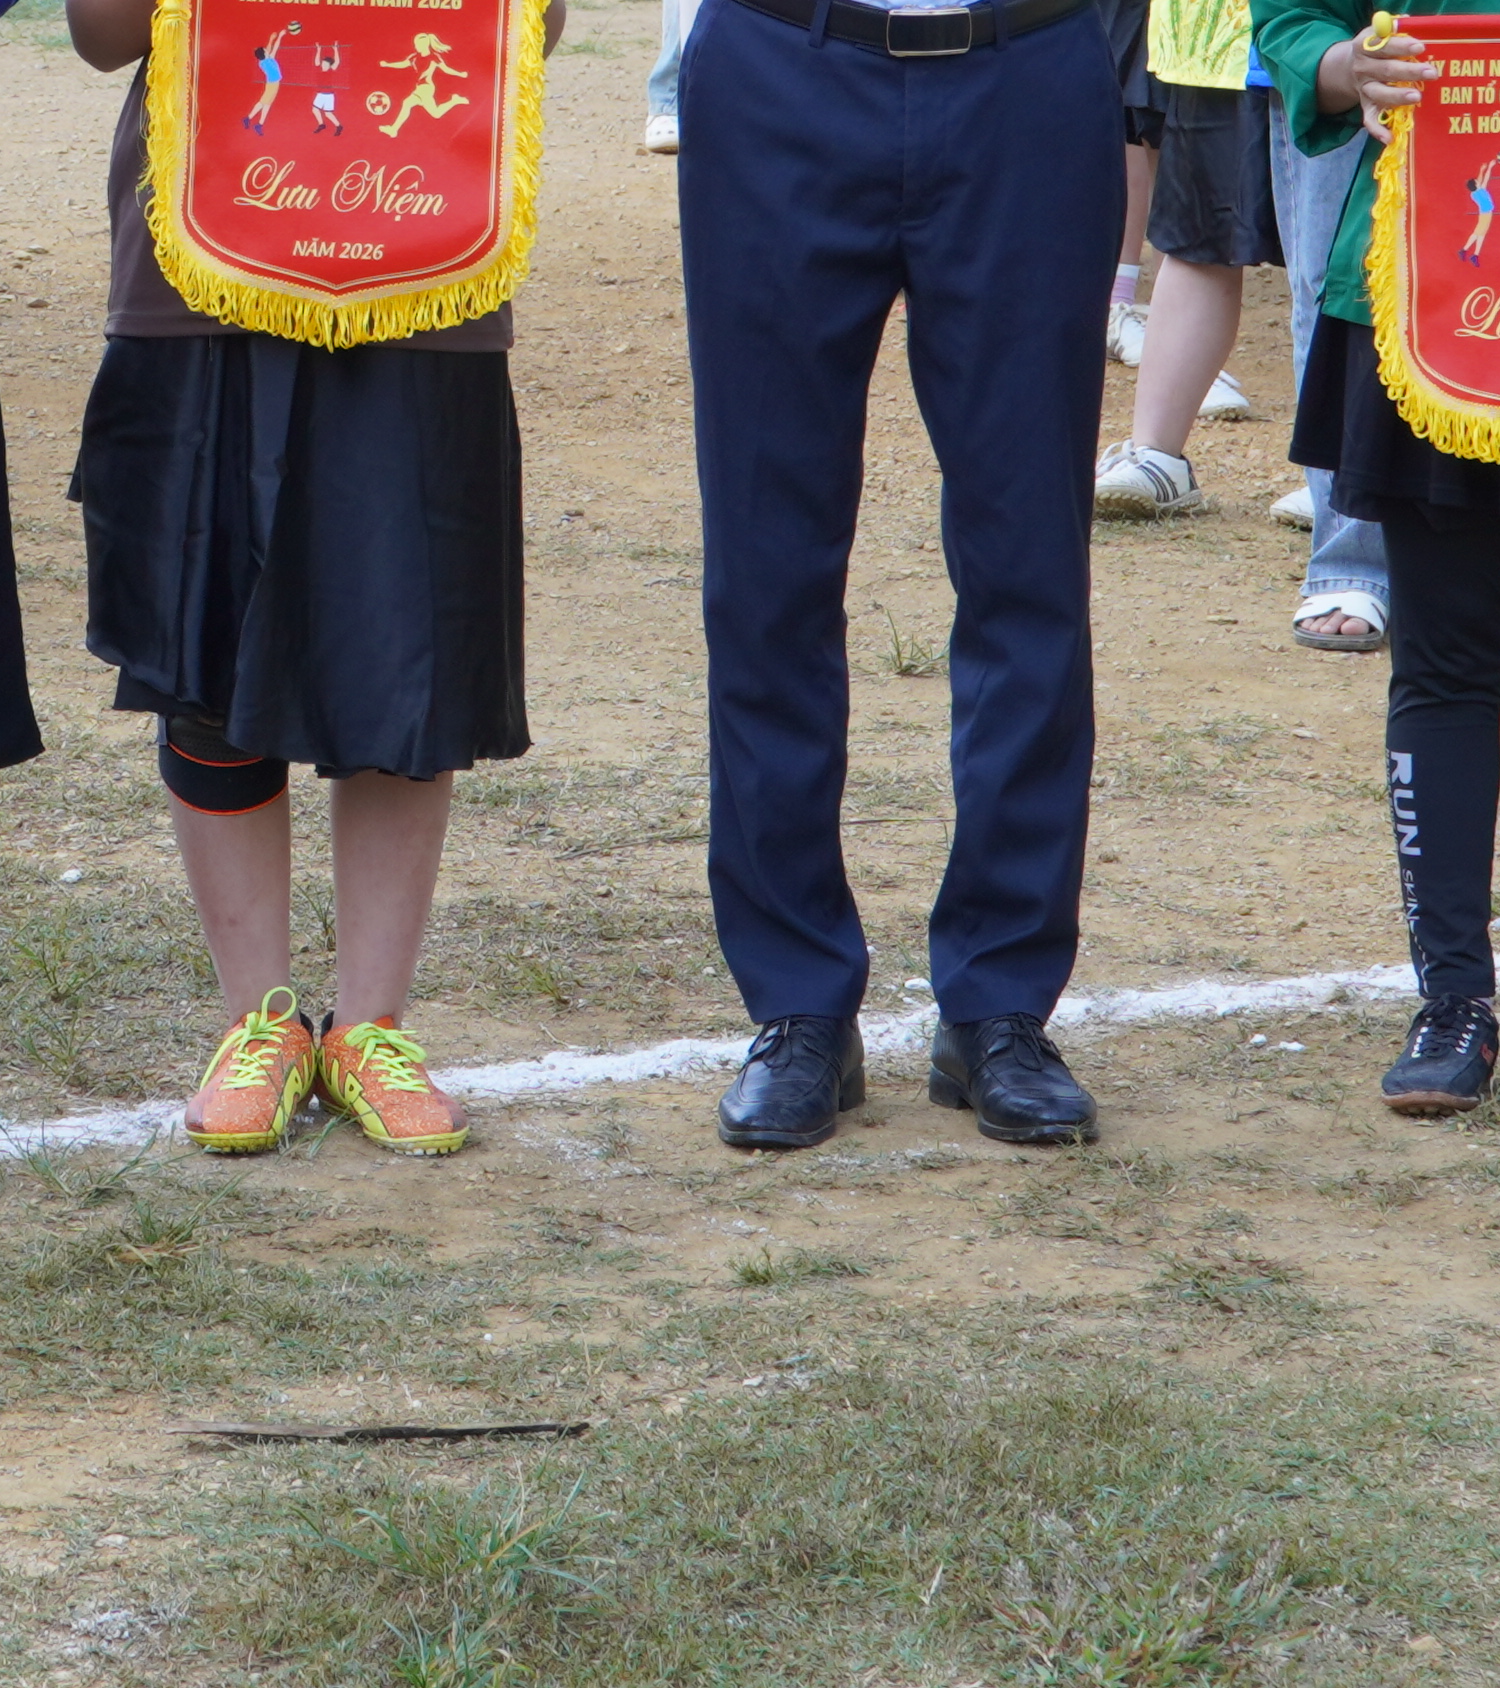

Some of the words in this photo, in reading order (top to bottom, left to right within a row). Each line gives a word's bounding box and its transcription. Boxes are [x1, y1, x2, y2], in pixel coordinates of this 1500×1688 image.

[1449, 59, 1485, 77] BAN
[1440, 86, 1473, 105] BAN
[1476, 79, 1497, 104] TỔ
[1448, 113, 1474, 134] XÃ
[233, 156, 321, 211] Lưu
[330, 159, 451, 222] Niệm
[292, 237, 336, 258] NĂM
[338, 241, 385, 261] 2026
[1390, 751, 1422, 856] RUN
